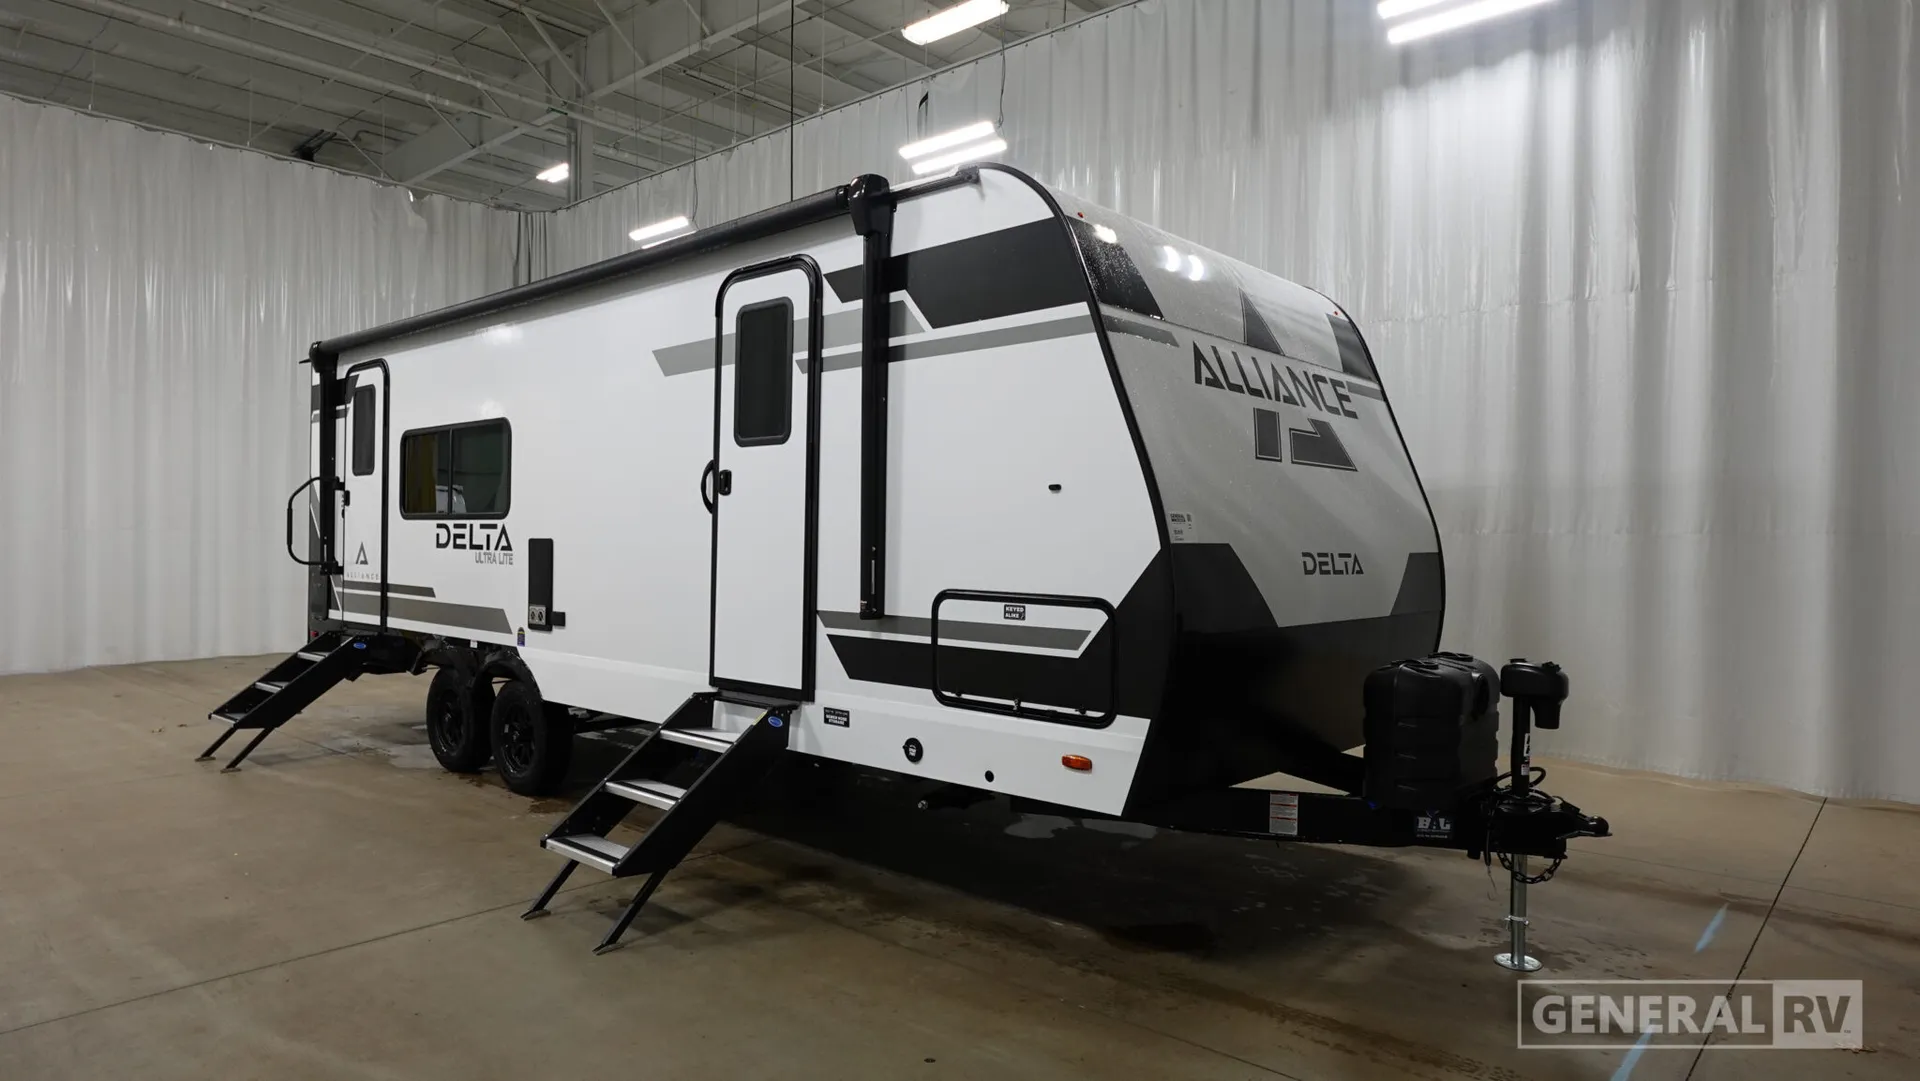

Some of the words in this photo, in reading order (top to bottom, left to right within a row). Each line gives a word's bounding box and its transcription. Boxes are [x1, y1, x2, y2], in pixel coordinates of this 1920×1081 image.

[1193, 341, 1359, 419] ALLIANCE
[436, 523, 513, 551] DELTA
[475, 552, 497, 565] ULTRA
[498, 552, 513, 566] LITE
[1302, 551, 1364, 575] DELTA
